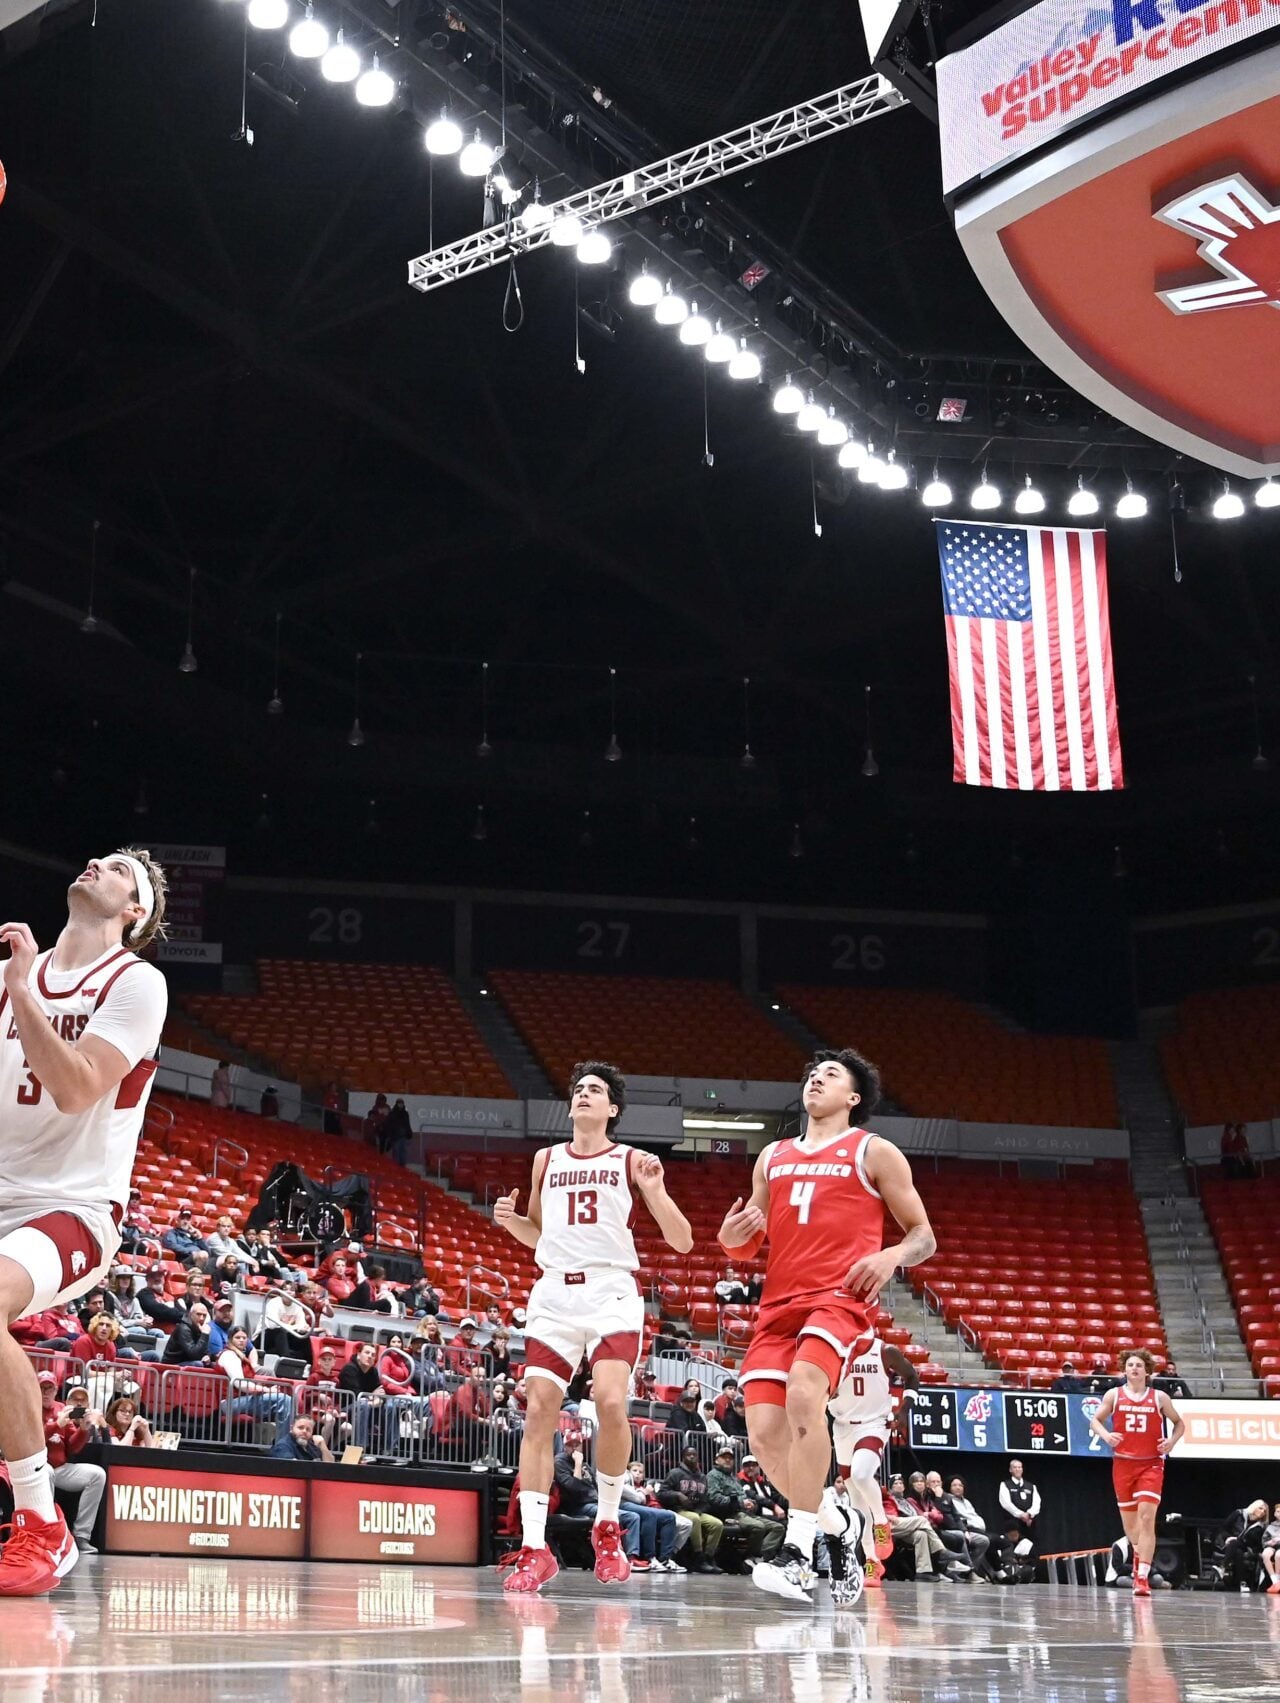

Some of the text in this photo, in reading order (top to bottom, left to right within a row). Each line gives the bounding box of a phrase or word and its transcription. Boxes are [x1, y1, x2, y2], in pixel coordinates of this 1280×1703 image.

[980, 32, 1103, 117] valley
[1000, 0, 1280, 140] supercen
[308, 907, 364, 944] 28
[577, 921, 631, 958] 27
[162, 946, 208, 958] TOYOTA
[830, 934, 886, 971] 26
[417, 1106, 498, 1122] CRIMSON
[715, 1140, 730, 1153] 28
[549, 1168, 621, 1189] COUGARS
[792, 1163, 853, 1178] MEXICO
[566, 1189, 599, 1226] 13
[788, 1181, 816, 1225] 4
[852, 1376, 865, 1397] 0
[914, 1394, 950, 1410] TOL 4
[1014, 1398, 1059, 1419] 15:06
[913, 1413, 952, 1430] FLS 0
[1030, 1423, 1045, 1437] 29
[1125, 1413, 1148, 1433] 23
[973, 1424, 988, 1448] 5
[111, 1484, 302, 1531] WASHINGTON STATE
[358, 1499, 437, 1537] COUGARS
